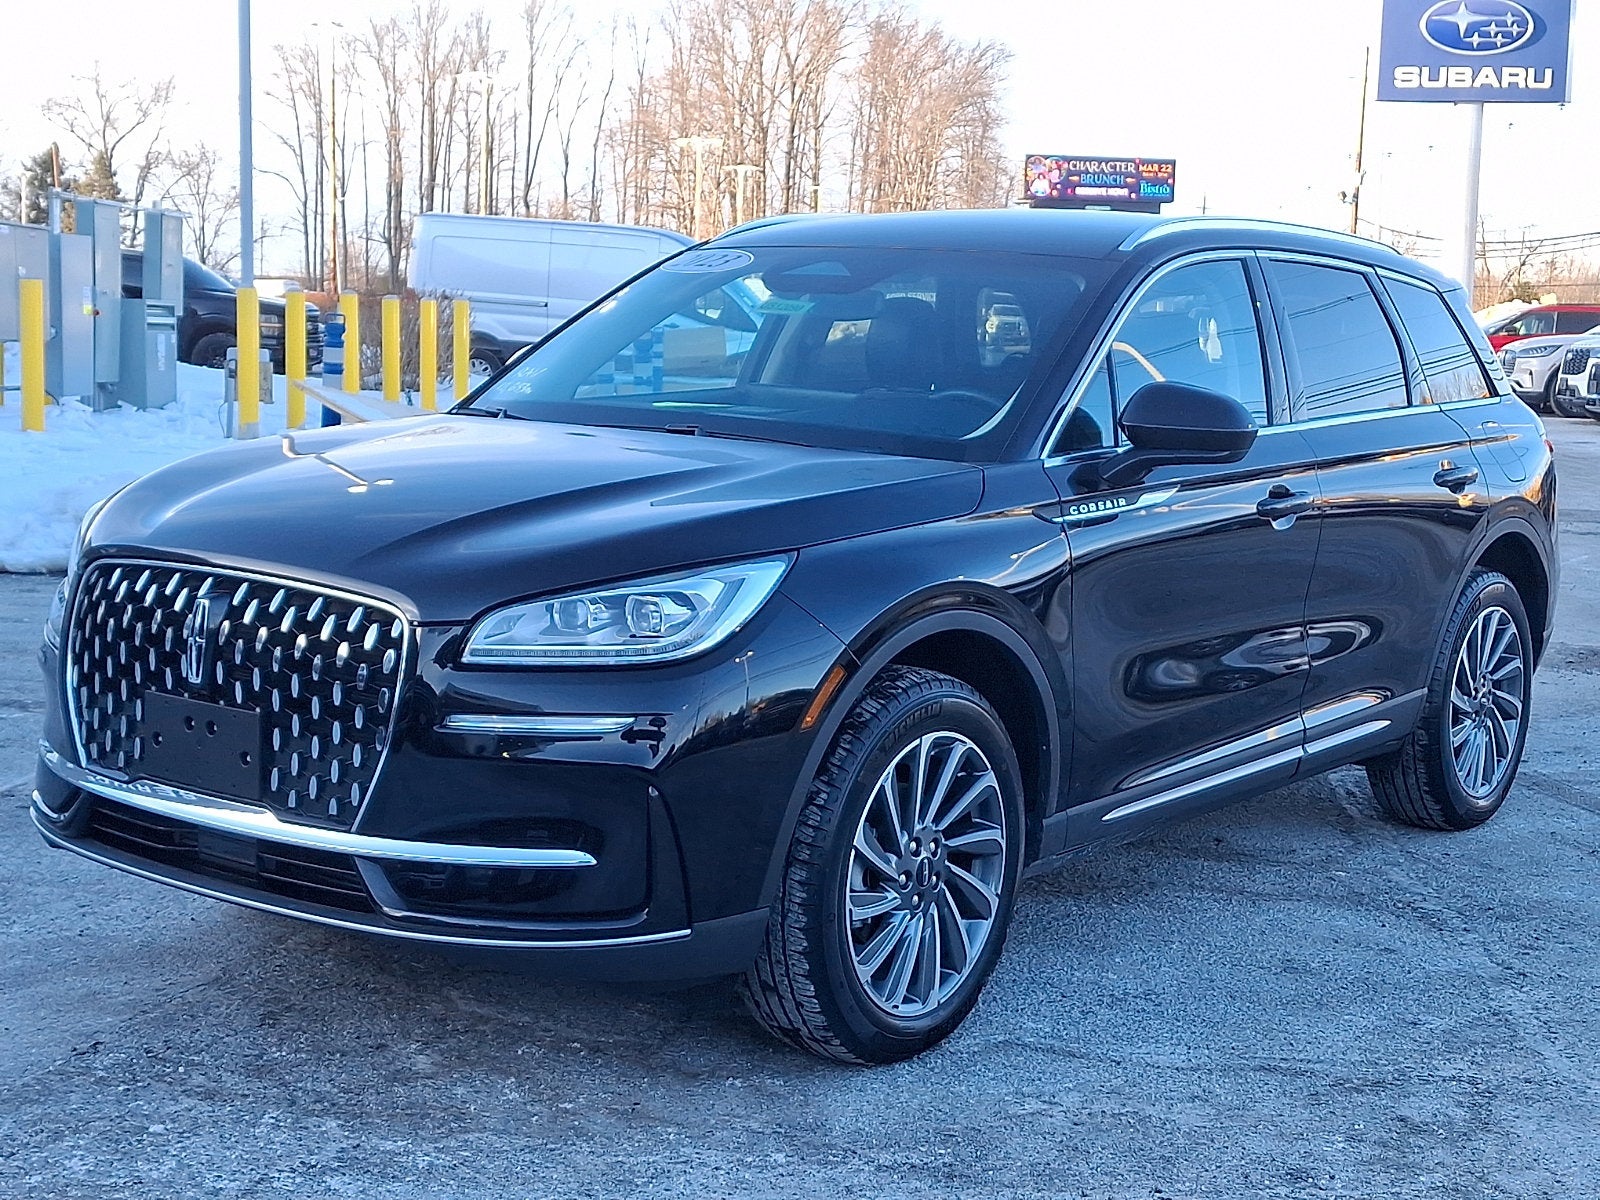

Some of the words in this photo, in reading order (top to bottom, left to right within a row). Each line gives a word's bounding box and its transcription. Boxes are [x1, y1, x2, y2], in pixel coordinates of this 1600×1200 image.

[1393, 65, 1553, 89] SUBARU
[1069, 160, 1136, 173] CHARACTER
[1139, 163, 1158, 172] MAR
[1160, 164, 1172, 173] 22
[1080, 173, 1124, 185] BRUNCH
[1069, 497, 1127, 515] CORSAIR
